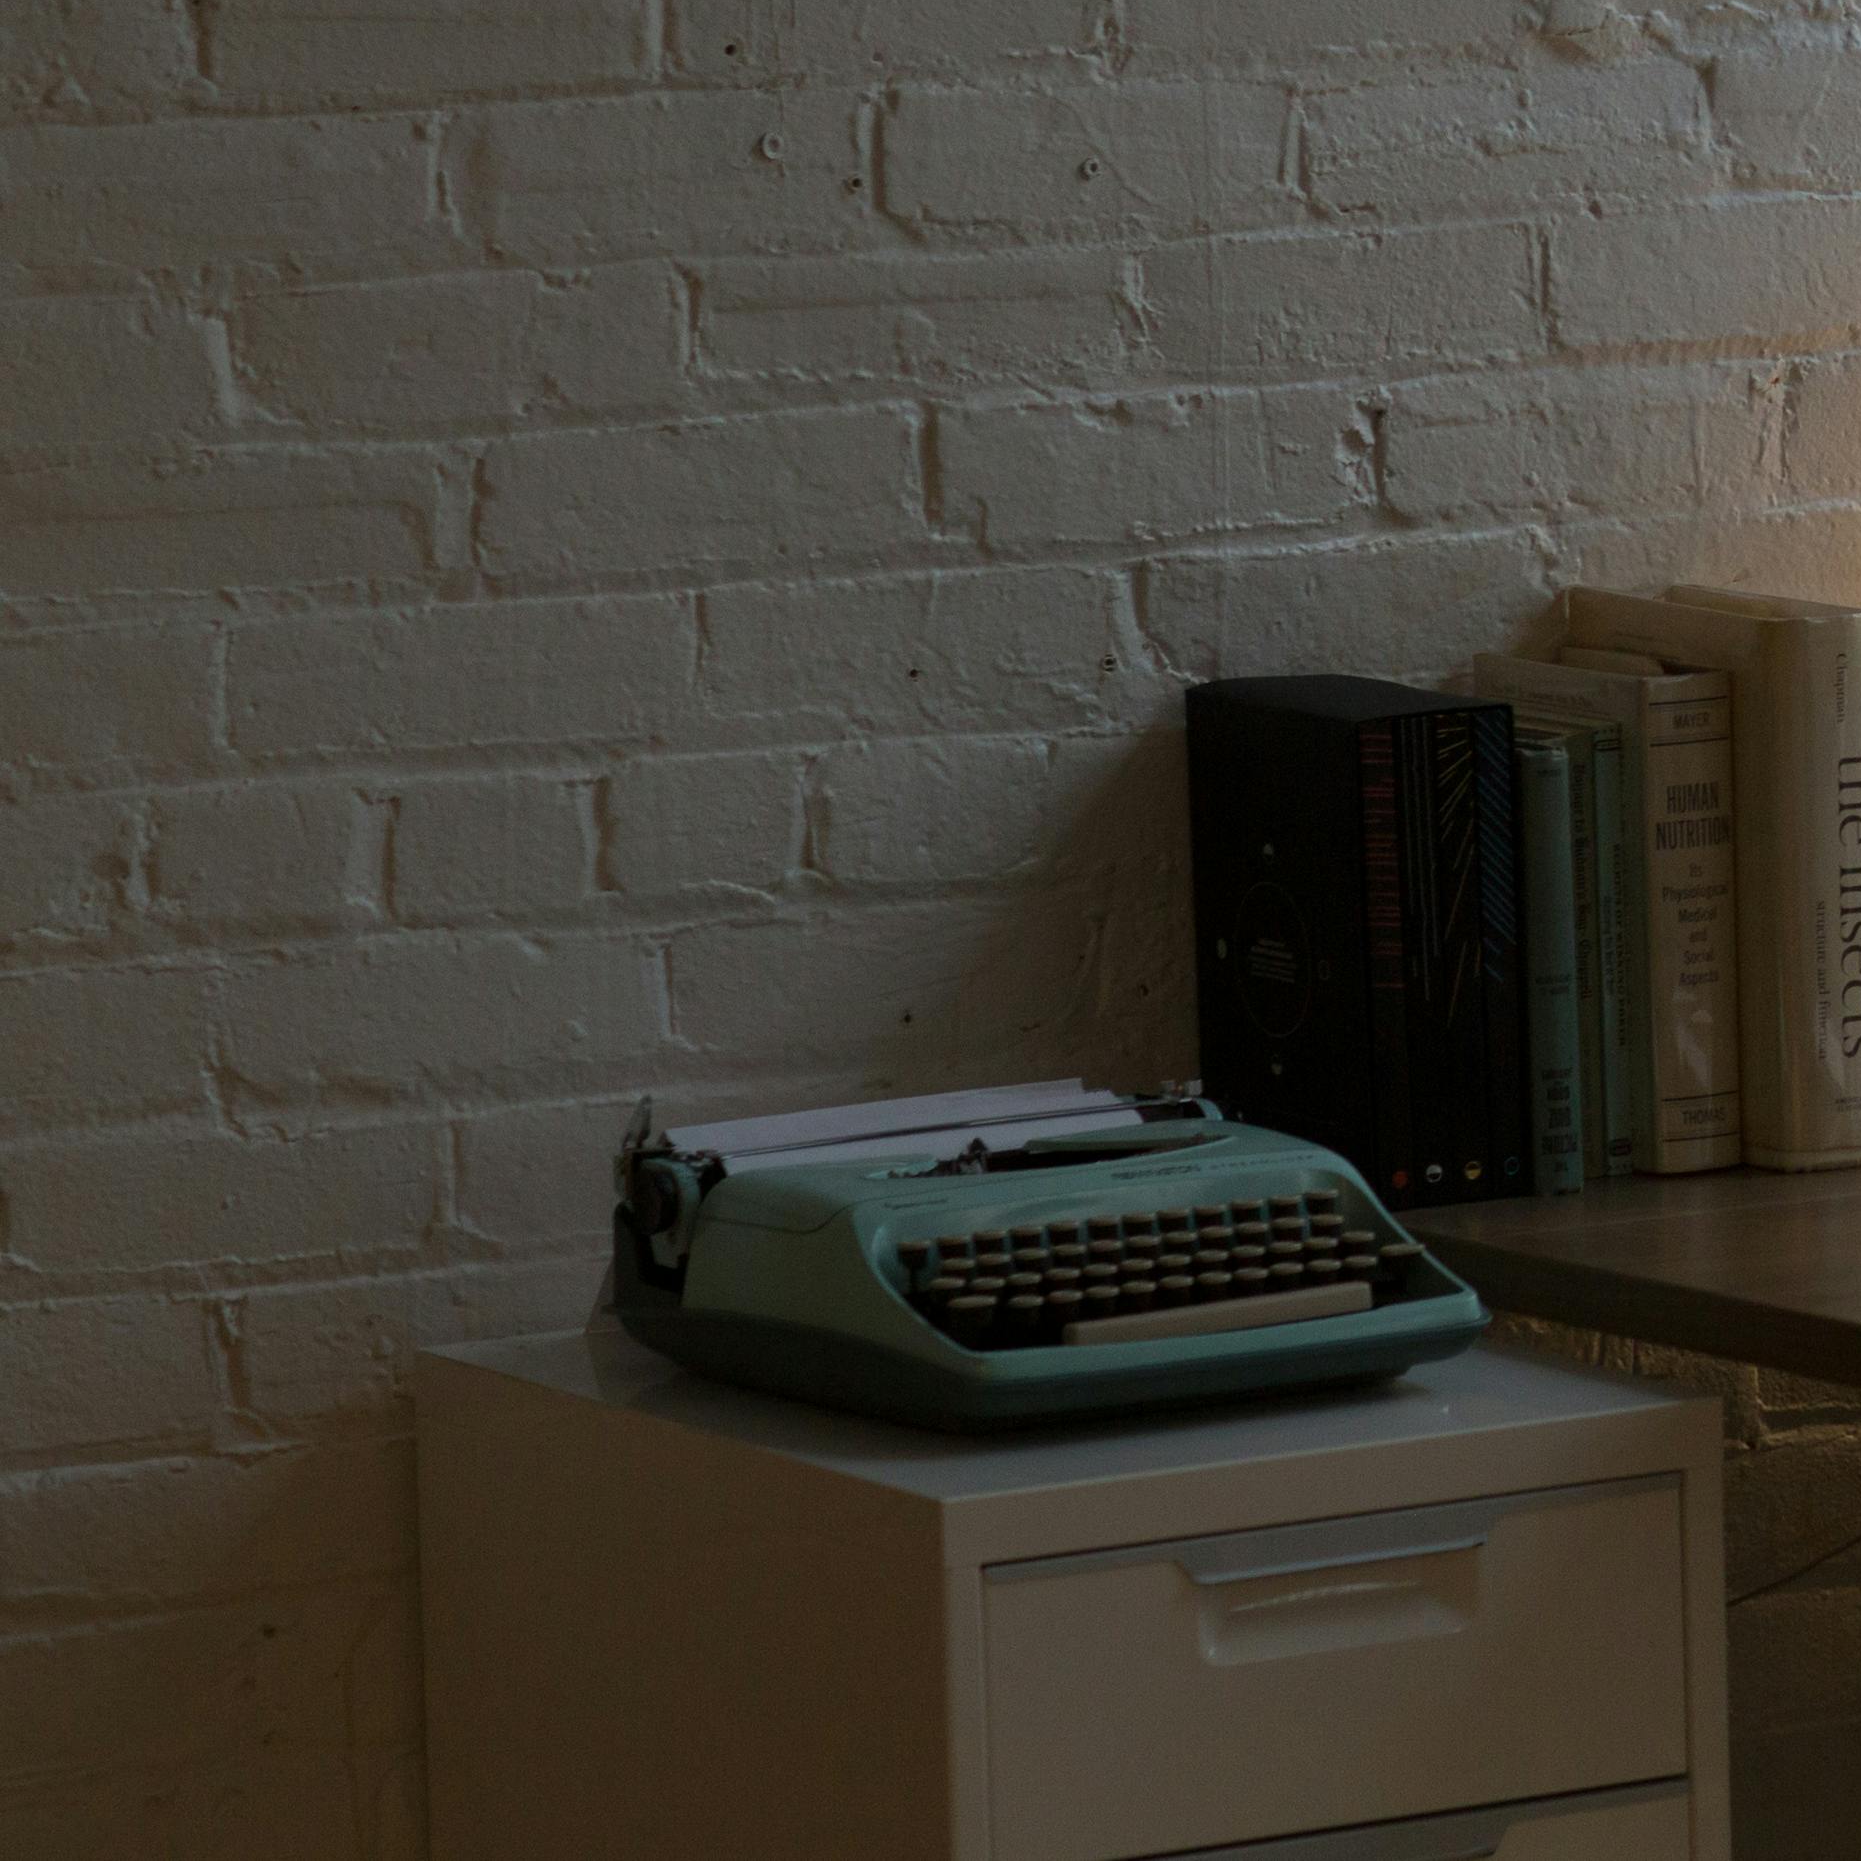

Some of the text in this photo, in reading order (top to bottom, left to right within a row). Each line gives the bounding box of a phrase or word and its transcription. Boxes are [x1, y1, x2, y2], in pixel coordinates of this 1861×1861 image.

[1834, 653, 1847, 722] Chapman
[1673, 711, 1710, 729] MAYER
[1667, 781, 1719, 814] HUMAN
[1656, 816, 1732, 851] NUTRITION
[1678, 906, 1718, 923] Medical
[1816, 901, 1827, 963] structure
[1683, 949, 1715, 965] Social
[1679, 971, 1719, 986] Aspects
[1817, 969, 1830, 995] and
[1681, 1108, 1726, 1126] THOMAS
